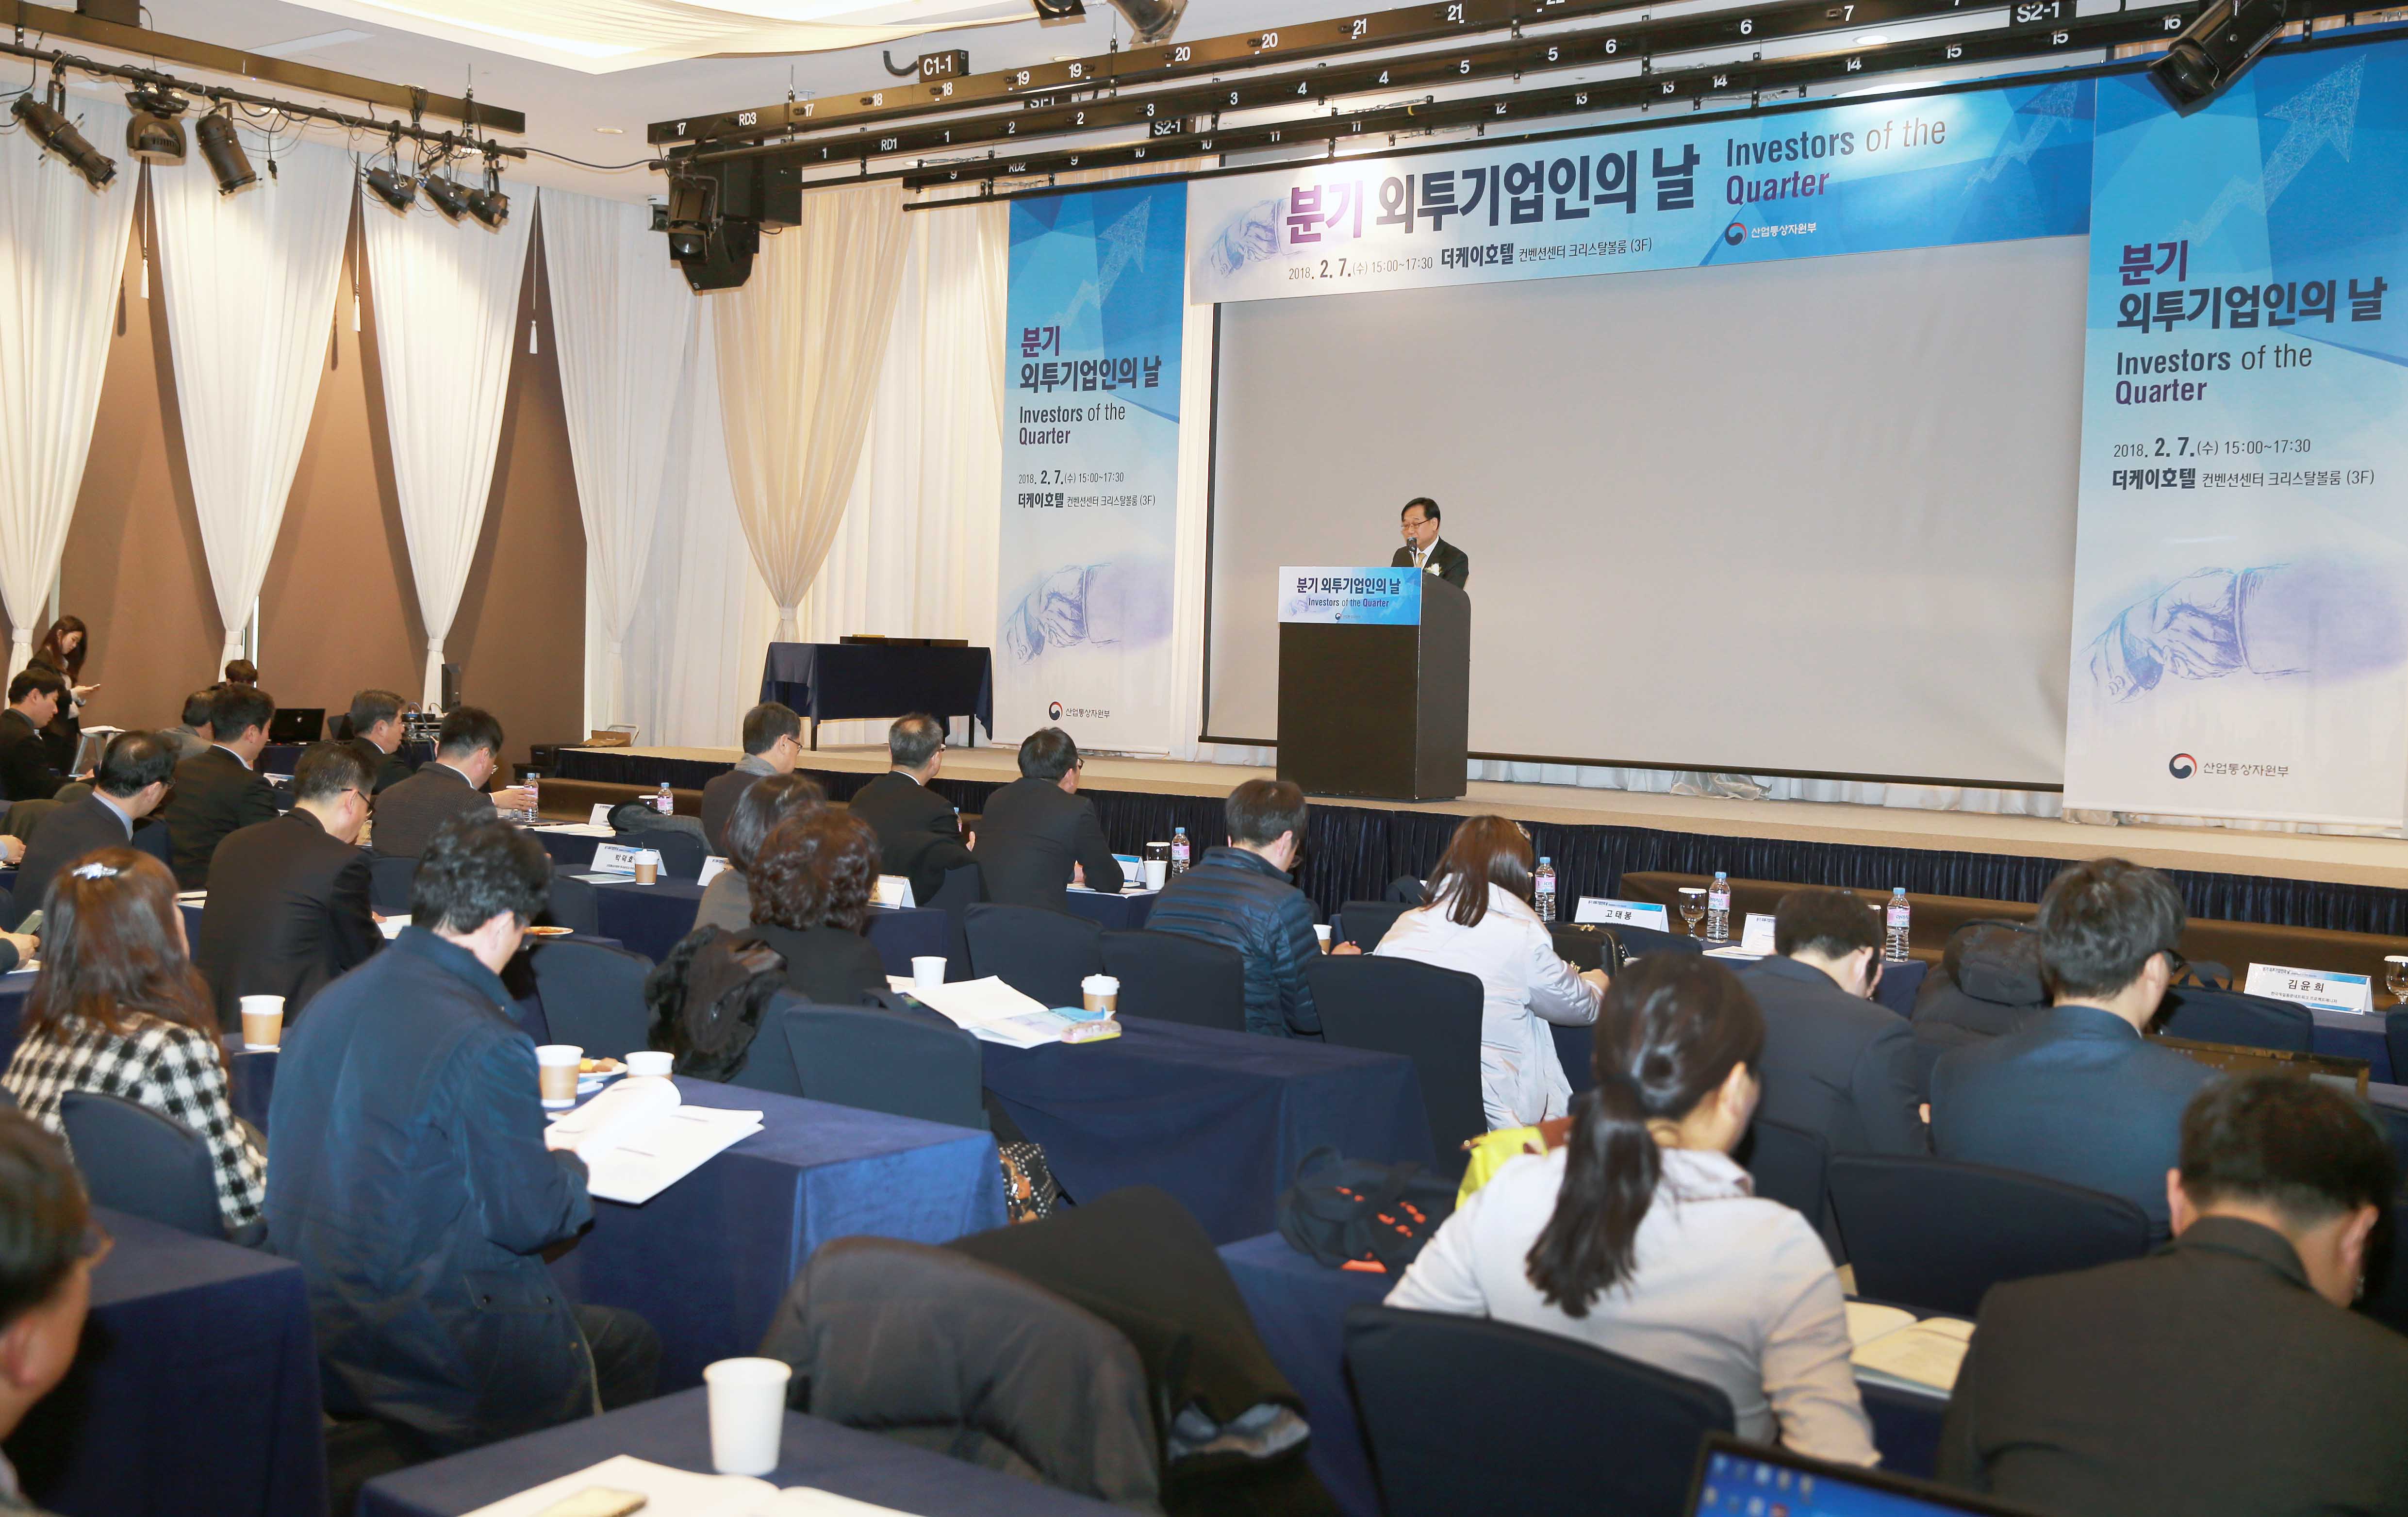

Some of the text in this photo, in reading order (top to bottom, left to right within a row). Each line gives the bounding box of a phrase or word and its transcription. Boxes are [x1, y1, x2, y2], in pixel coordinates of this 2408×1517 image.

[1448, 4, 1462, 21] 21
[1845, 6, 1854, 21] 7
[2017, 2, 2059, 23] S2-1
[1353, 19, 1367, 35] 21
[1741, 19, 1752, 34] 6
[2163, 15, 2180, 30] 16
[1262, 33, 1278, 48] 20
[2052, 30, 2068, 45] 15
[1606, 39, 1616, 53] 6
[1946, 45, 1962, 59] 15
[1175, 47, 1190, 62] 20
[1548, 47, 1558, 62] 5
[924, 56, 952, 75] C1-1
[1069, 64, 1082, 78] 19
[1460, 60, 1470, 74] 5
[1847, 58, 1862, 72] 14
[1017, 71, 1029, 85] 19
[1379, 71, 1389, 84] 4
[1714, 75, 1727, 88] 14
[942, 82, 952, 96] 18
[1298, 82, 1306, 95] 4
[873, 93, 882, 106] 18
[1230, 92, 1237, 105] 3
[804, 103, 814, 117] 17
[1147, 104, 1155, 116] 3
[1495, 103, 1506, 114] 12
[739, 112, 757, 126] RD3
[1077, 112, 1084, 124] 2
[677, 122, 686, 135] 17
[1008, 122, 1015, 133] 2
[1155, 119, 1180, 135] S2-1
[1352, 121, 1361, 132] 11
[881, 137, 897, 150] RD1
[945, 132, 949, 142] 1
[1270, 131, 1281, 142] 11
[1727, 118, 1946, 167] Investors of the
[1201, 139, 1212, 150] 10
[822, 148, 827, 158] 1
[1135, 148, 1145, 158] 10
[1286, 143, 1700, 244] 분기 외투기업인의 날
[1726, 171, 1830, 206] Quarter
[1751, 222, 1816, 238] 산업통상자원부
[1289, 266, 1315, 280] 2018.
[1372, 255, 1433, 273] 15:00~17:30
[1441, 243, 1514, 268] 더케이호텔
[1519, 244, 1566, 263] 컨벤션센터
[1568, 240, 1626, 258] 크리스탈볼룸
[1631, 236, 1652, 254] (3F)
[2119, 240, 2188, 286] 분기
[2117, 277, 2387, 334] 외투기업인의 날
[1021, 326, 1060, 357] 분기
[2117, 344, 2311, 375] Investors of the
[1020, 355, 1161, 393] 외투기업인의 날
[2116, 379, 2207, 405] Quarter
[1020, 403, 1125, 423] Investors of the
[1020, 428, 1070, 445] Quarter
[2114, 444, 2147, 458] 2018.
[2225, 439, 2310, 454] 15:00~17:30
[1019, 474, 1037, 484] 2018.
[1079, 473, 1123, 483] 15:00~17:30
[2112, 468, 2374, 490] 더케이호텔 컨벤션센터 크리스탈볼룸 (3F)
[1018, 493, 1155, 508] 더케이호텔 컨벤션센터 크리스탈볼룸 (3F)
[1297, 578, 1401, 594] 분기 외투기업인의 날
[1309, 598, 1339, 606] Investors
[1363, 599, 1389, 607] Quarter
[1066, 709, 1110, 718] 산업통상자원부
[2204, 762, 2289, 777] 산업통상자원부
[1605, 910, 1632, 920] 고태봉
[2288, 979, 2325, 993] 김윤희
